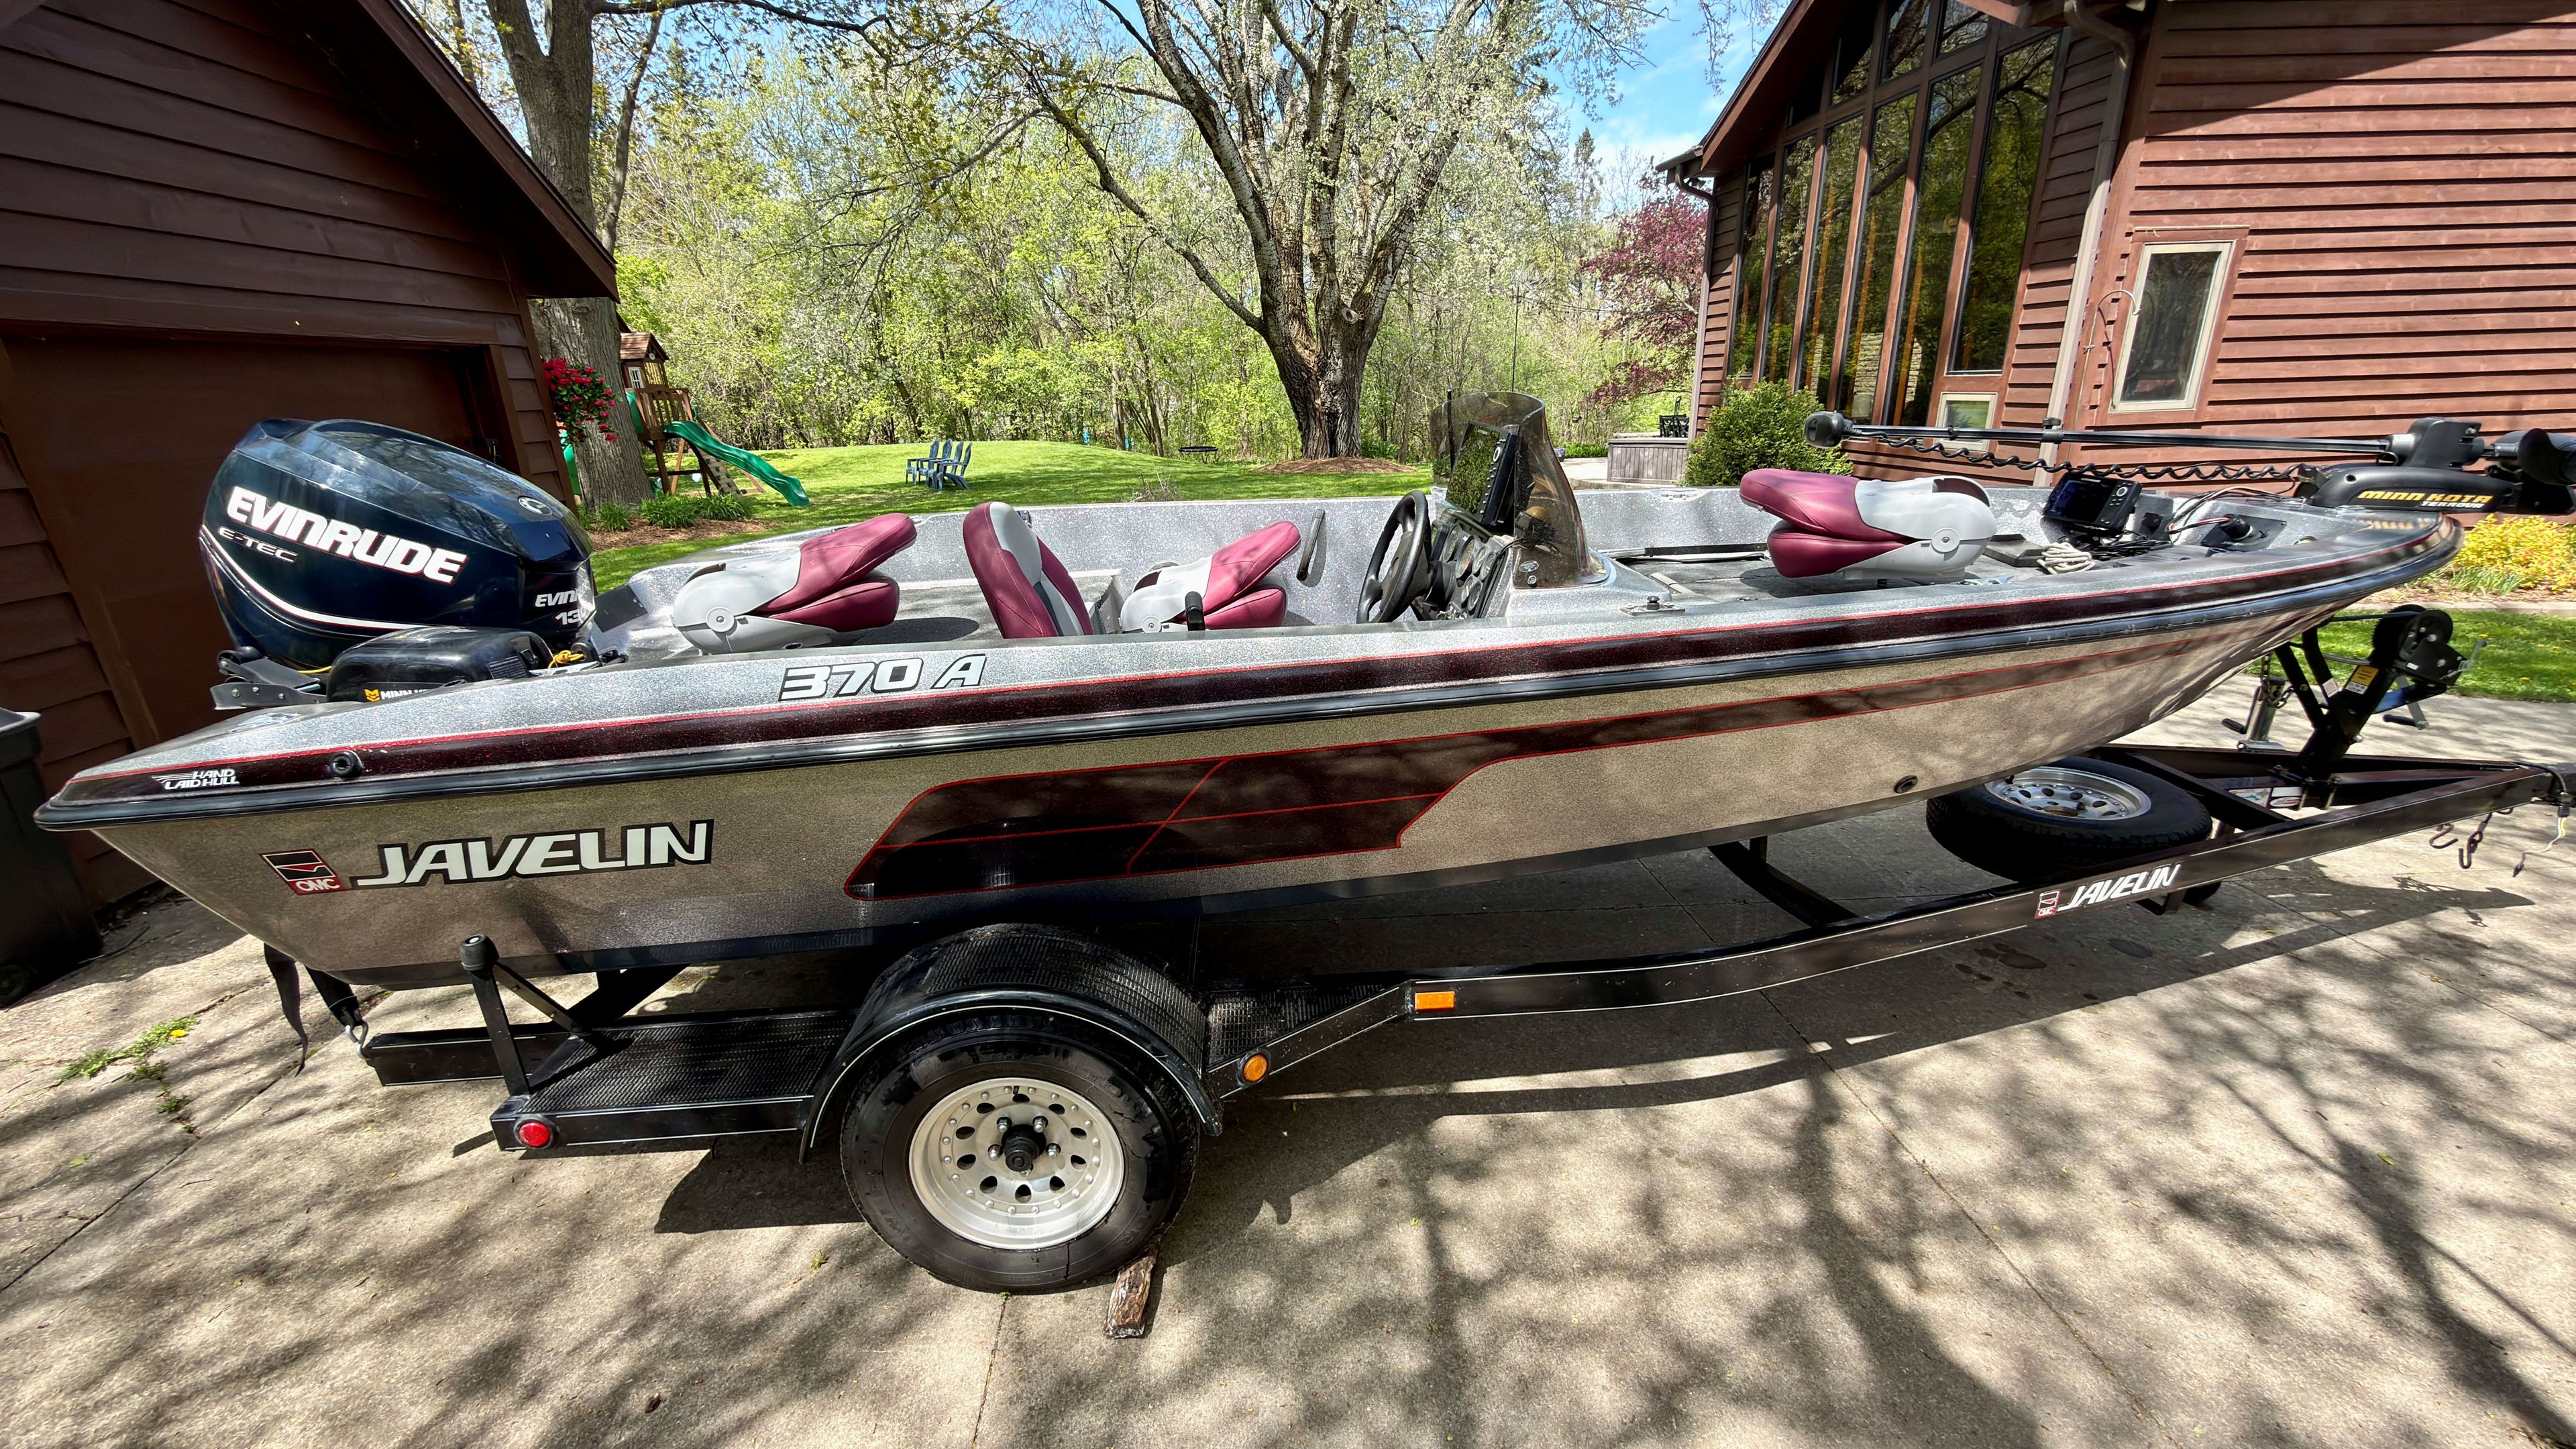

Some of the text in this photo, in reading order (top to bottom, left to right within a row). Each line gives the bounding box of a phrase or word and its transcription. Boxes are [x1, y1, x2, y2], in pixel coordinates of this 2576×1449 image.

[2357, 490, 2493, 504] MINN KOTA
[227, 485, 468, 584] EVINRUDE
[218, 526, 299, 563] E-TEC
[535, 590, 580, 607] EVIN
[555, 608, 581, 625] 13
[779, 653, 987, 702] 370 A
[164, 776, 240, 790] LAID HULL
[192, 769, 235, 780] HAND
[355, 821, 710, 888] JAVELIN
[296, 878, 340, 892] OMC
[2057, 863, 2182, 912] JAVELIN
[2037, 908, 2054, 917] OMC
